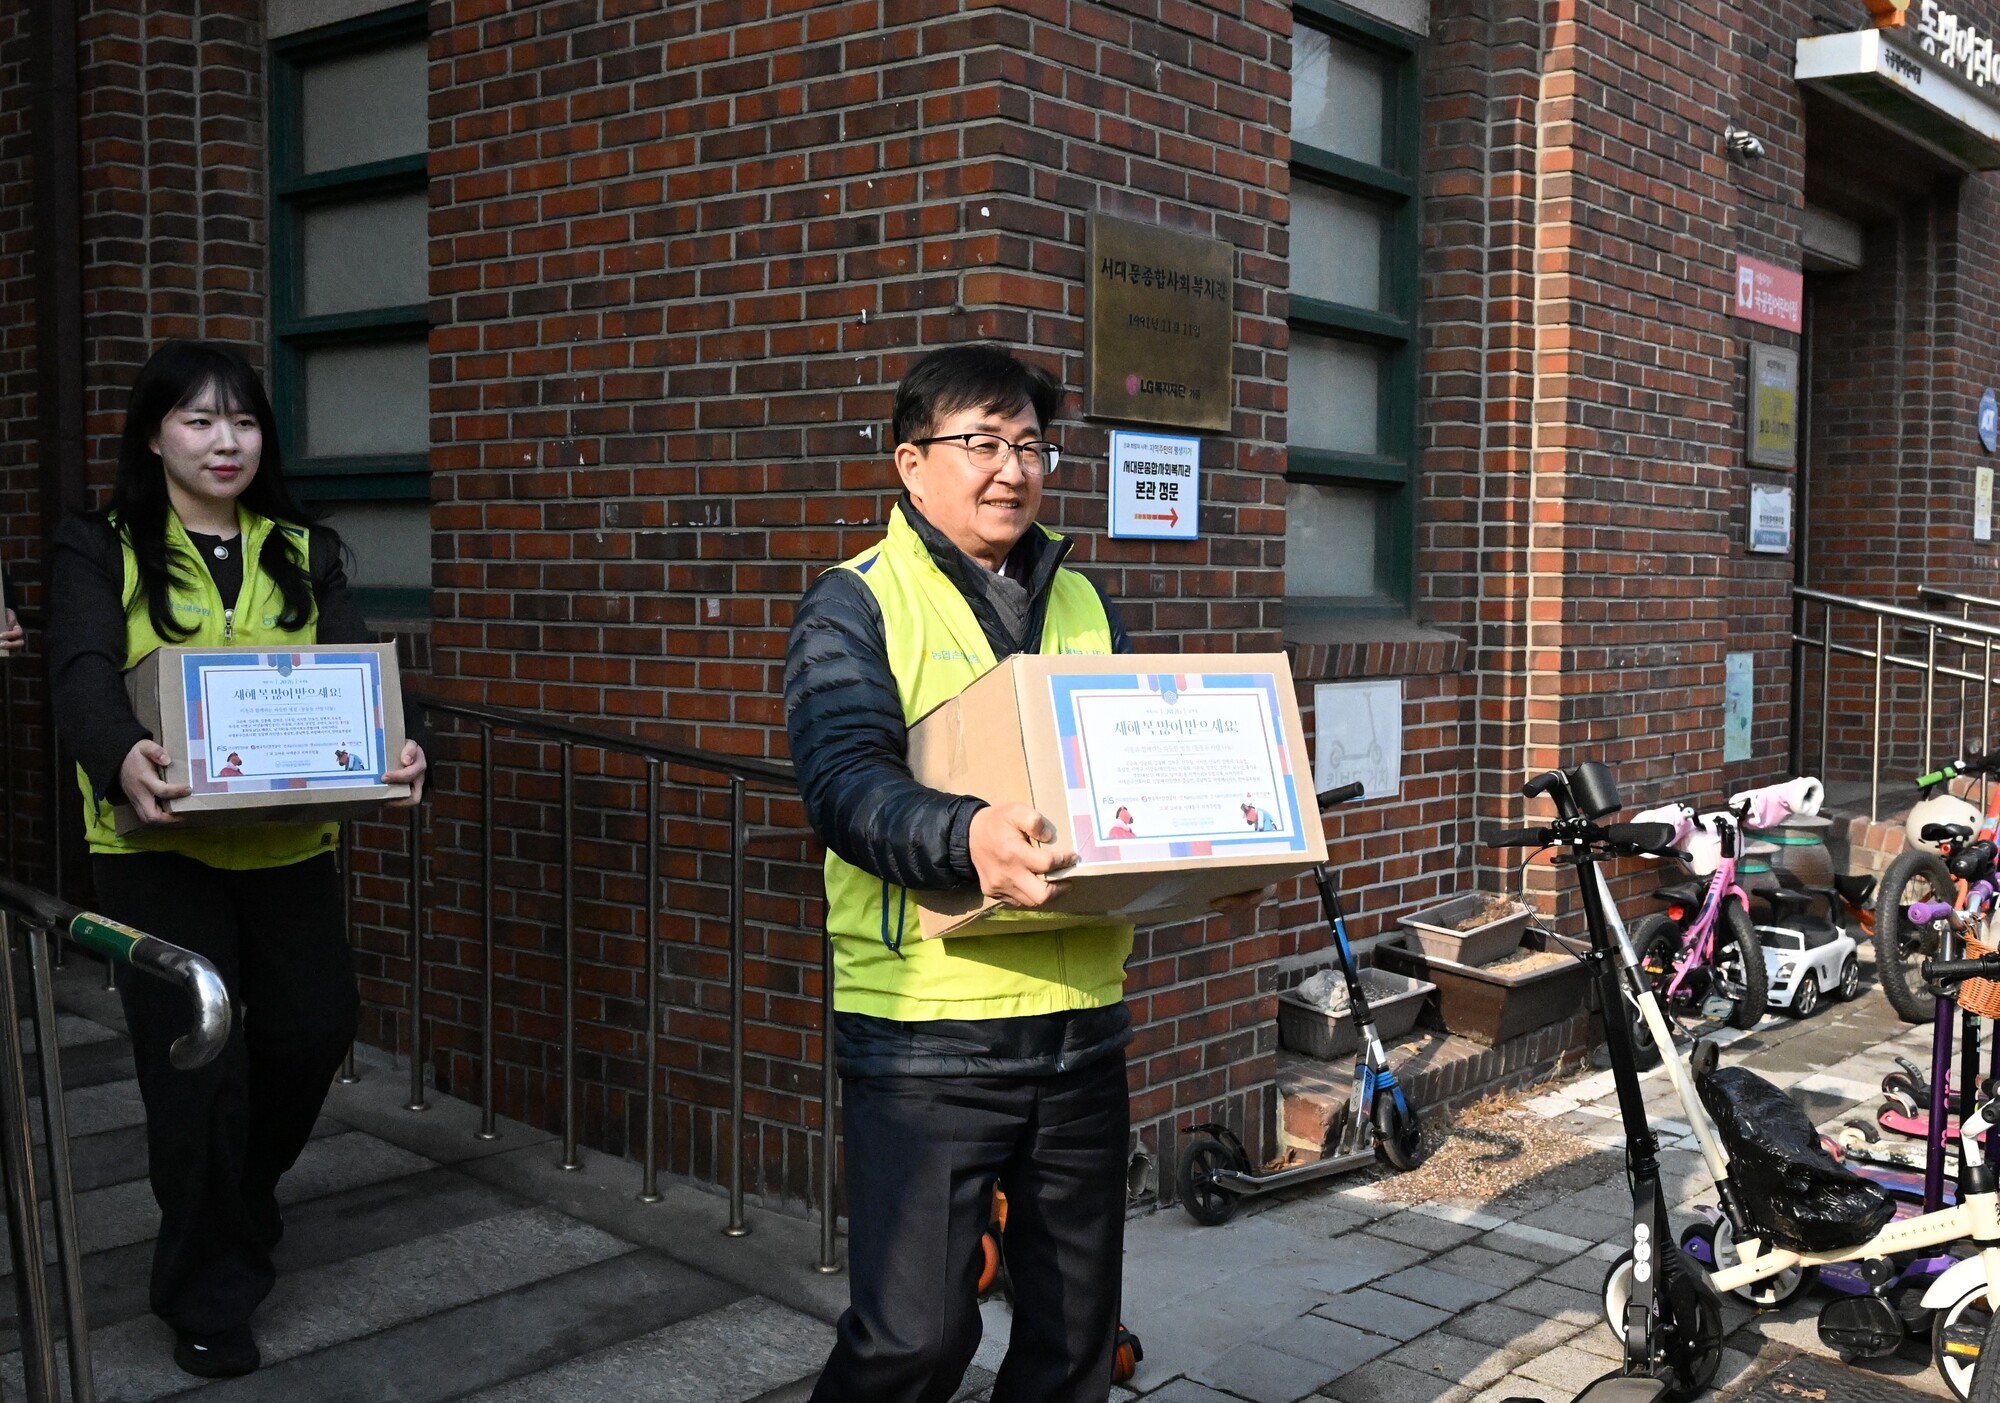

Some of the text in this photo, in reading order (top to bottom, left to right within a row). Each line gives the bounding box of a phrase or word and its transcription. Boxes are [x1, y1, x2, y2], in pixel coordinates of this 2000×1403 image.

[1123, 460, 1191, 477] 서대문종합사회복지관
[1136, 480, 1179, 501] 본관 정문
[233, 686, 342, 701] 새해 복 많이 받으세요!
[1114, 718, 1239, 736] 새해 복 많이 받으세요!
